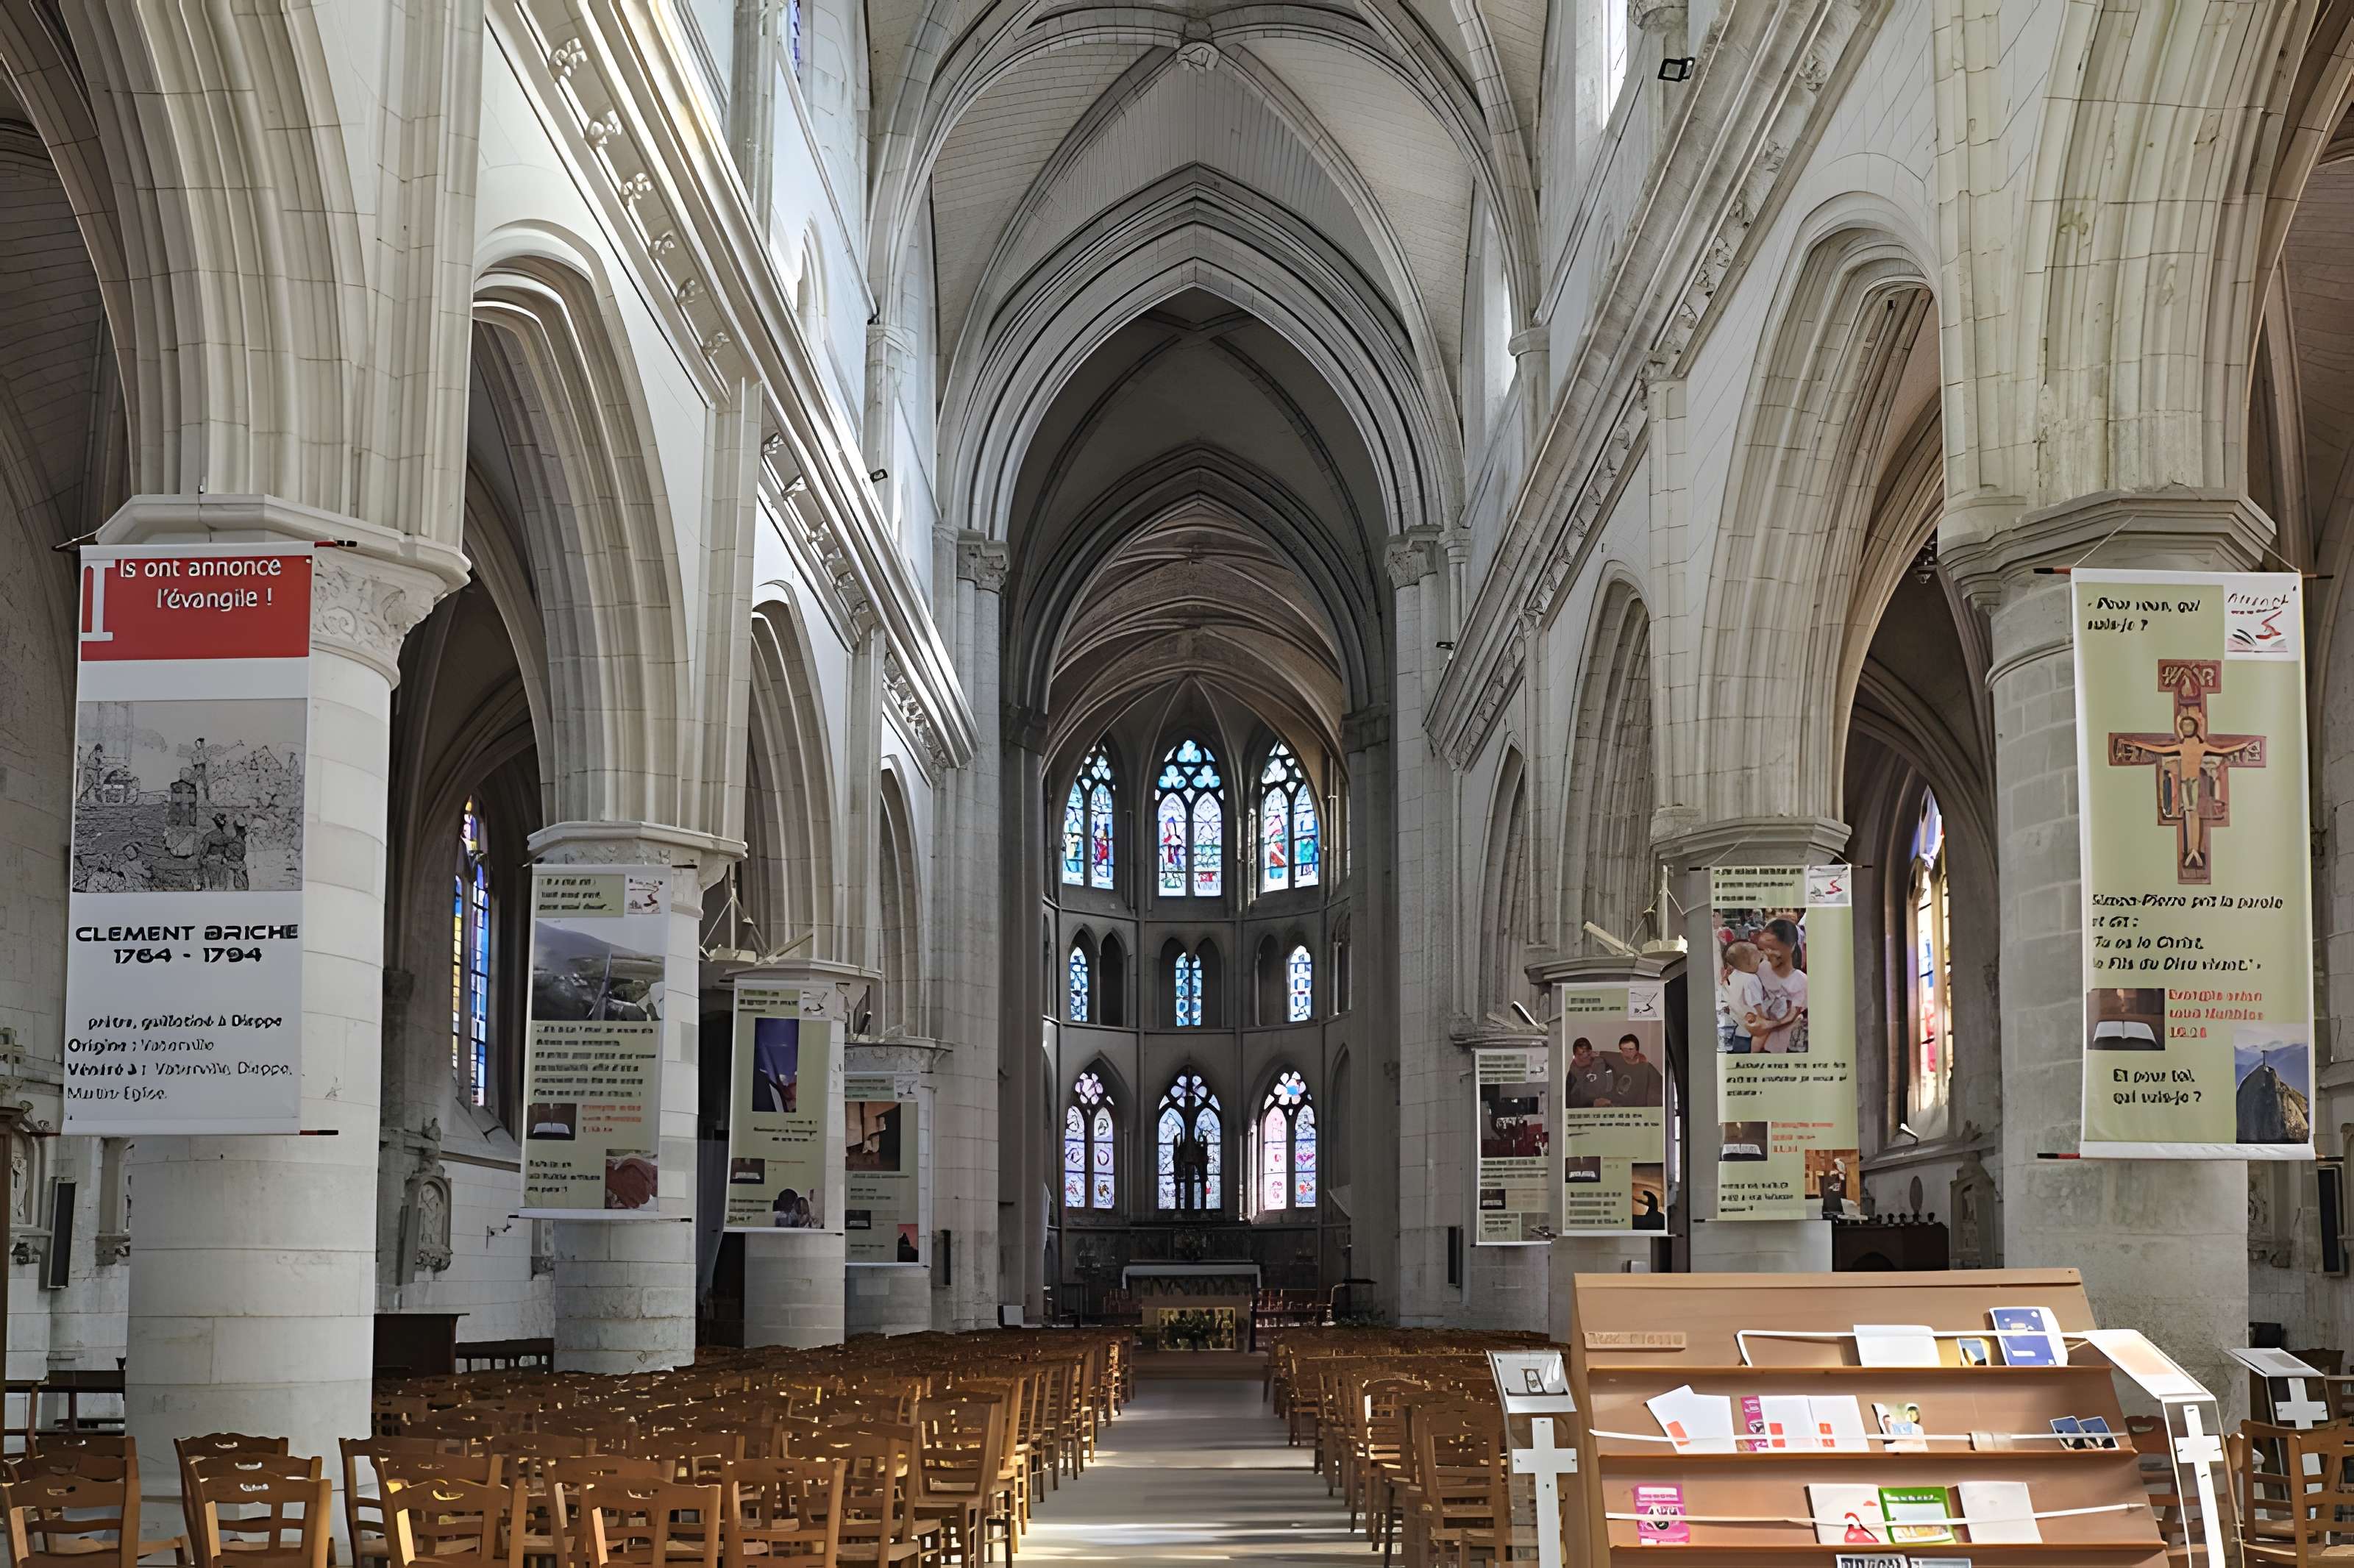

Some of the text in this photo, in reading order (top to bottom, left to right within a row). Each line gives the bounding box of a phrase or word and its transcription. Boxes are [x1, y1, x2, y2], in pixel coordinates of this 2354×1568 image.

[145, 560, 180, 578] ont
[157, 588, 272, 612] l'évangile !
[76, 924, 298, 942] CLEMENT BRICHE
[203, 947, 262, 963] 1794
[2194, 1091, 2202, 1102] ?
